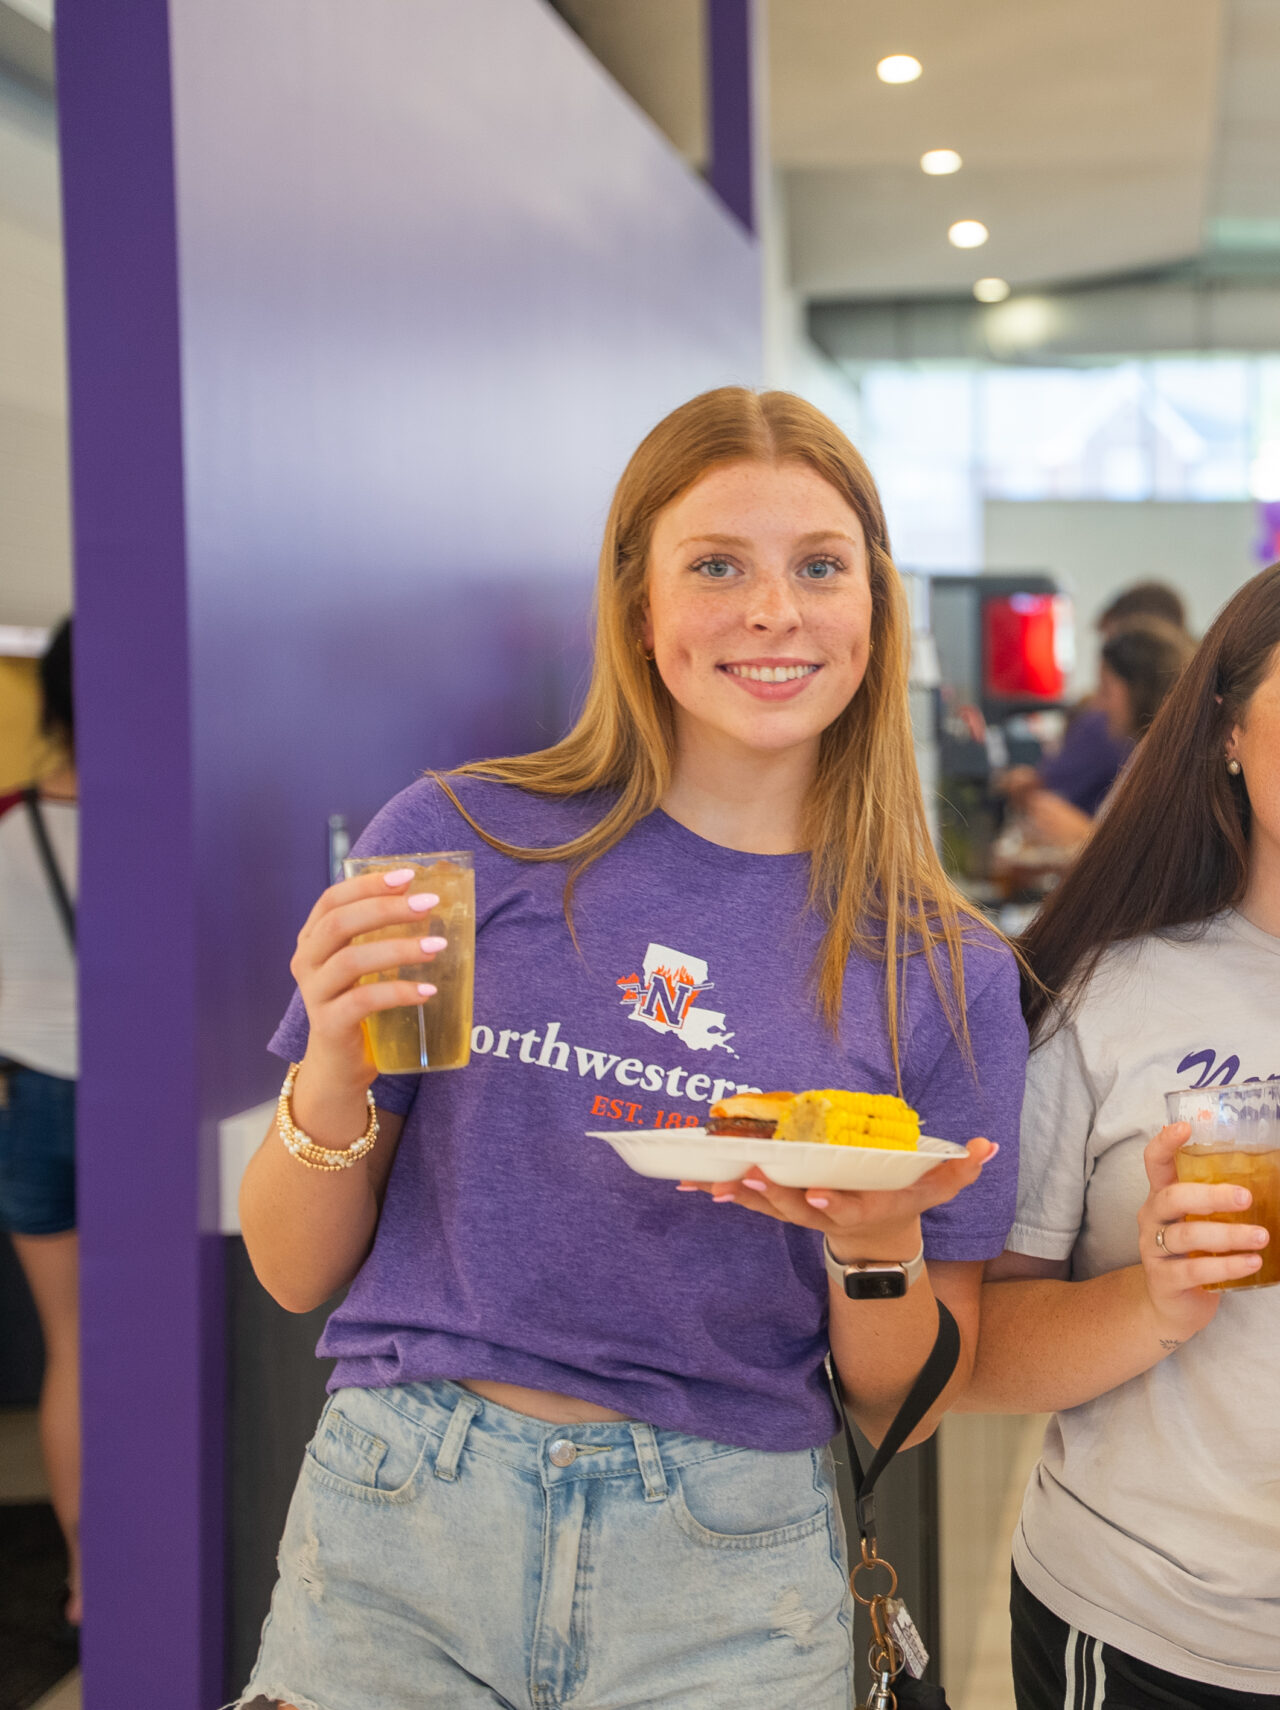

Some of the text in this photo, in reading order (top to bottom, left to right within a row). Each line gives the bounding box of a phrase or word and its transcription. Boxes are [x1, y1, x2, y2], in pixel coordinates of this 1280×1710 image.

[639, 971, 692, 1029] N
[470, 1022, 764, 1105] orthwester
[590, 1095, 699, 1129] EST. 188
